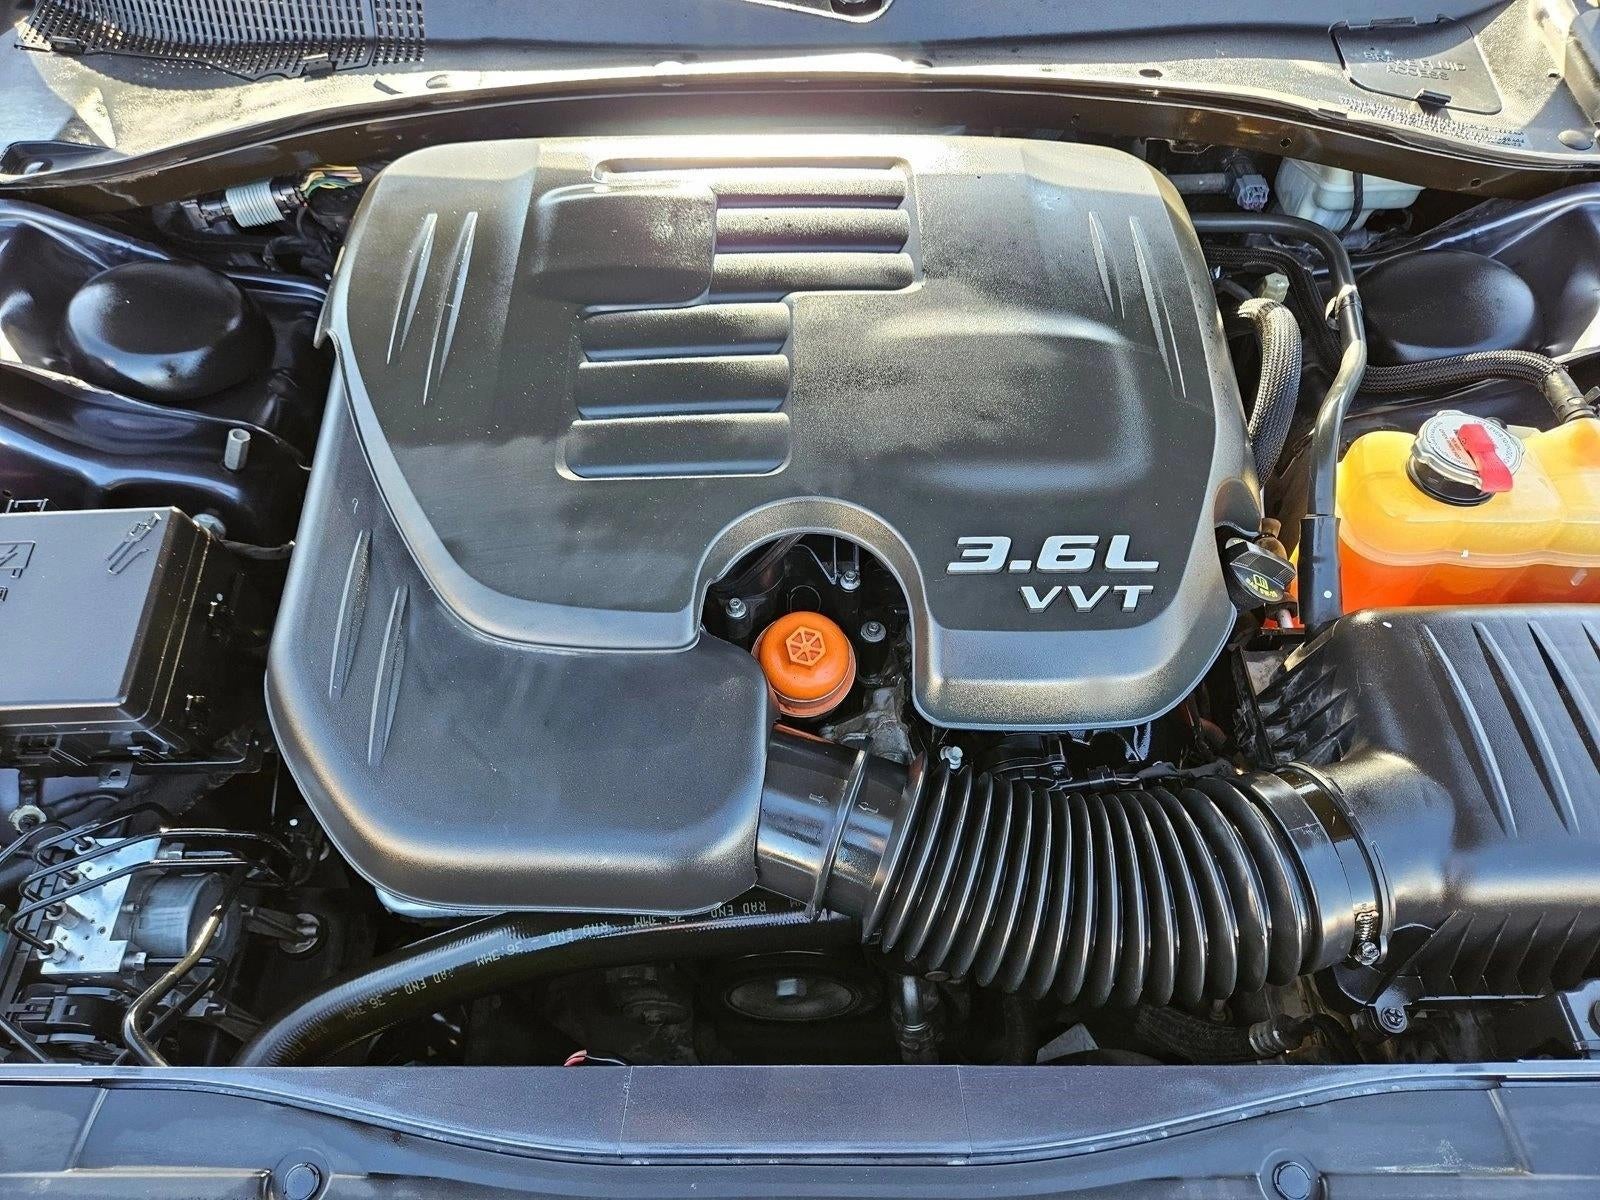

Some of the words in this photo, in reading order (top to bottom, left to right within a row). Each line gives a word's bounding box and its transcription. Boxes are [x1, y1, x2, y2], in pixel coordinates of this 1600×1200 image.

[1386, 65, 1449, 80] ACCESS
[1420, 60, 1466, 71] FLUID
[947, 534, 1160, 574] 3.6L
[1019, 585, 1154, 613] VVT
[710, 903, 734, 918] END
[743, 900, 767, 914] RAD
[634, 915, 685, 928] 363MM
[549, 928, 573, 944] END
[583, 921, 608, 938] RAD
[404, 976, 427, 996] END
